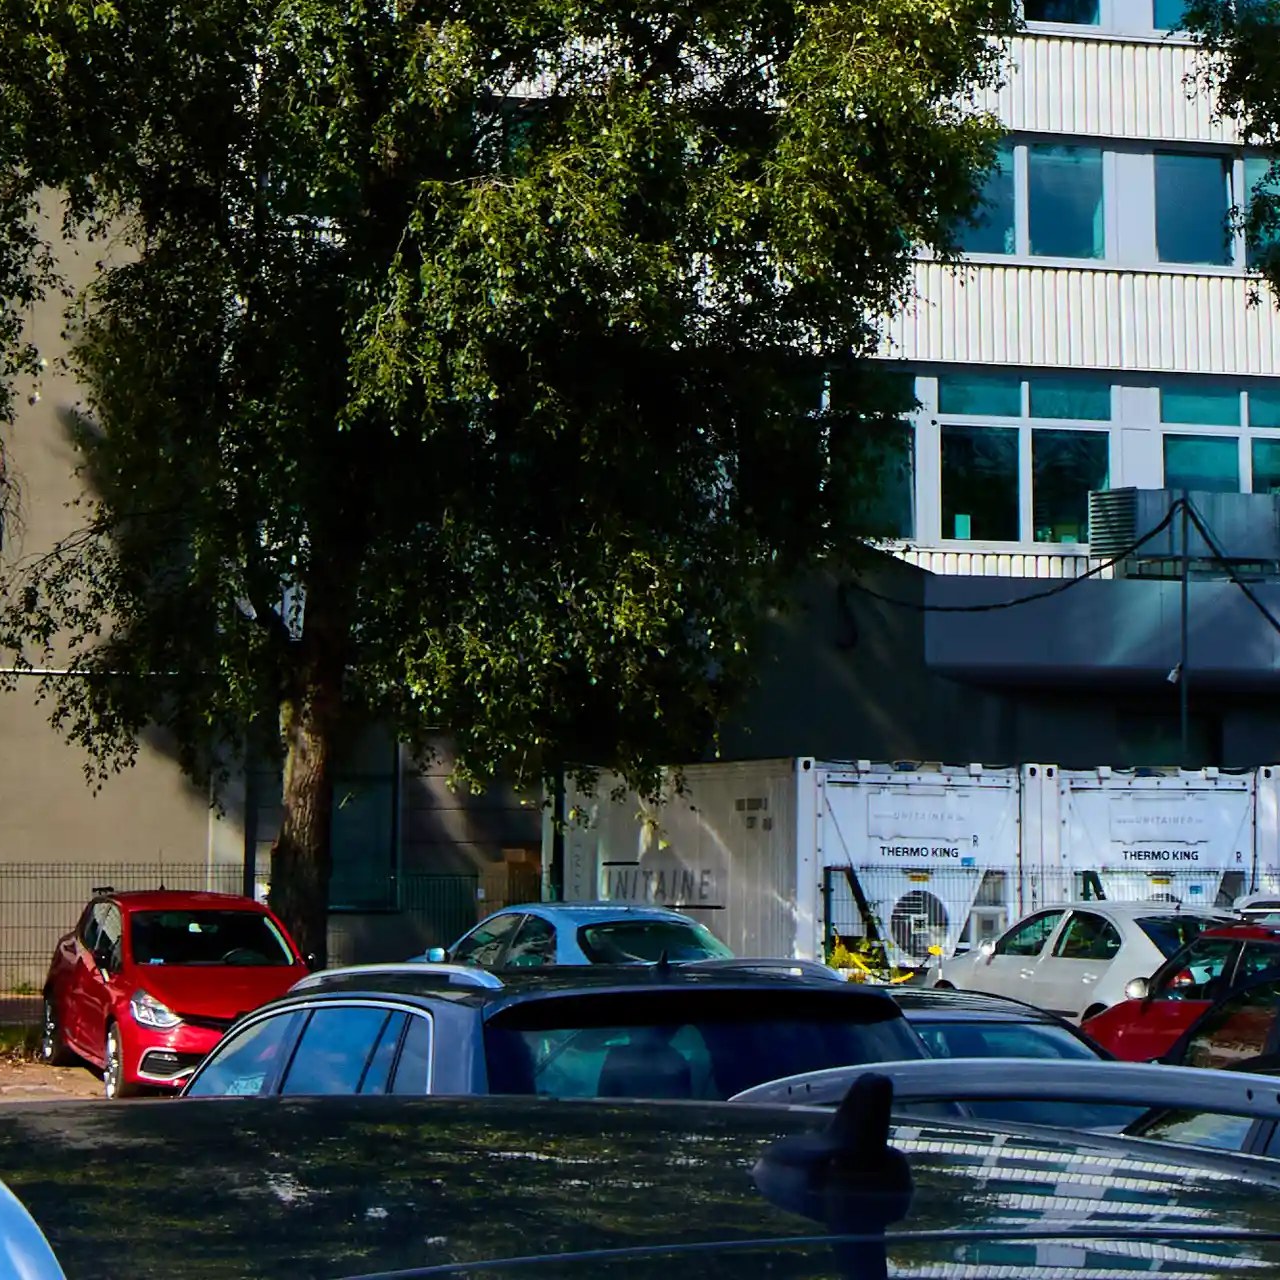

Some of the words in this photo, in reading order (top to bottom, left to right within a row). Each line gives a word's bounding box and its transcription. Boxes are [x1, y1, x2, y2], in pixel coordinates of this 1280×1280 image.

[880, 846, 929, 857] THERMO
[931, 847, 959, 858] KING
[1122, 850, 1170, 861] THERMO
[1172, 850, 1199, 861] KING
